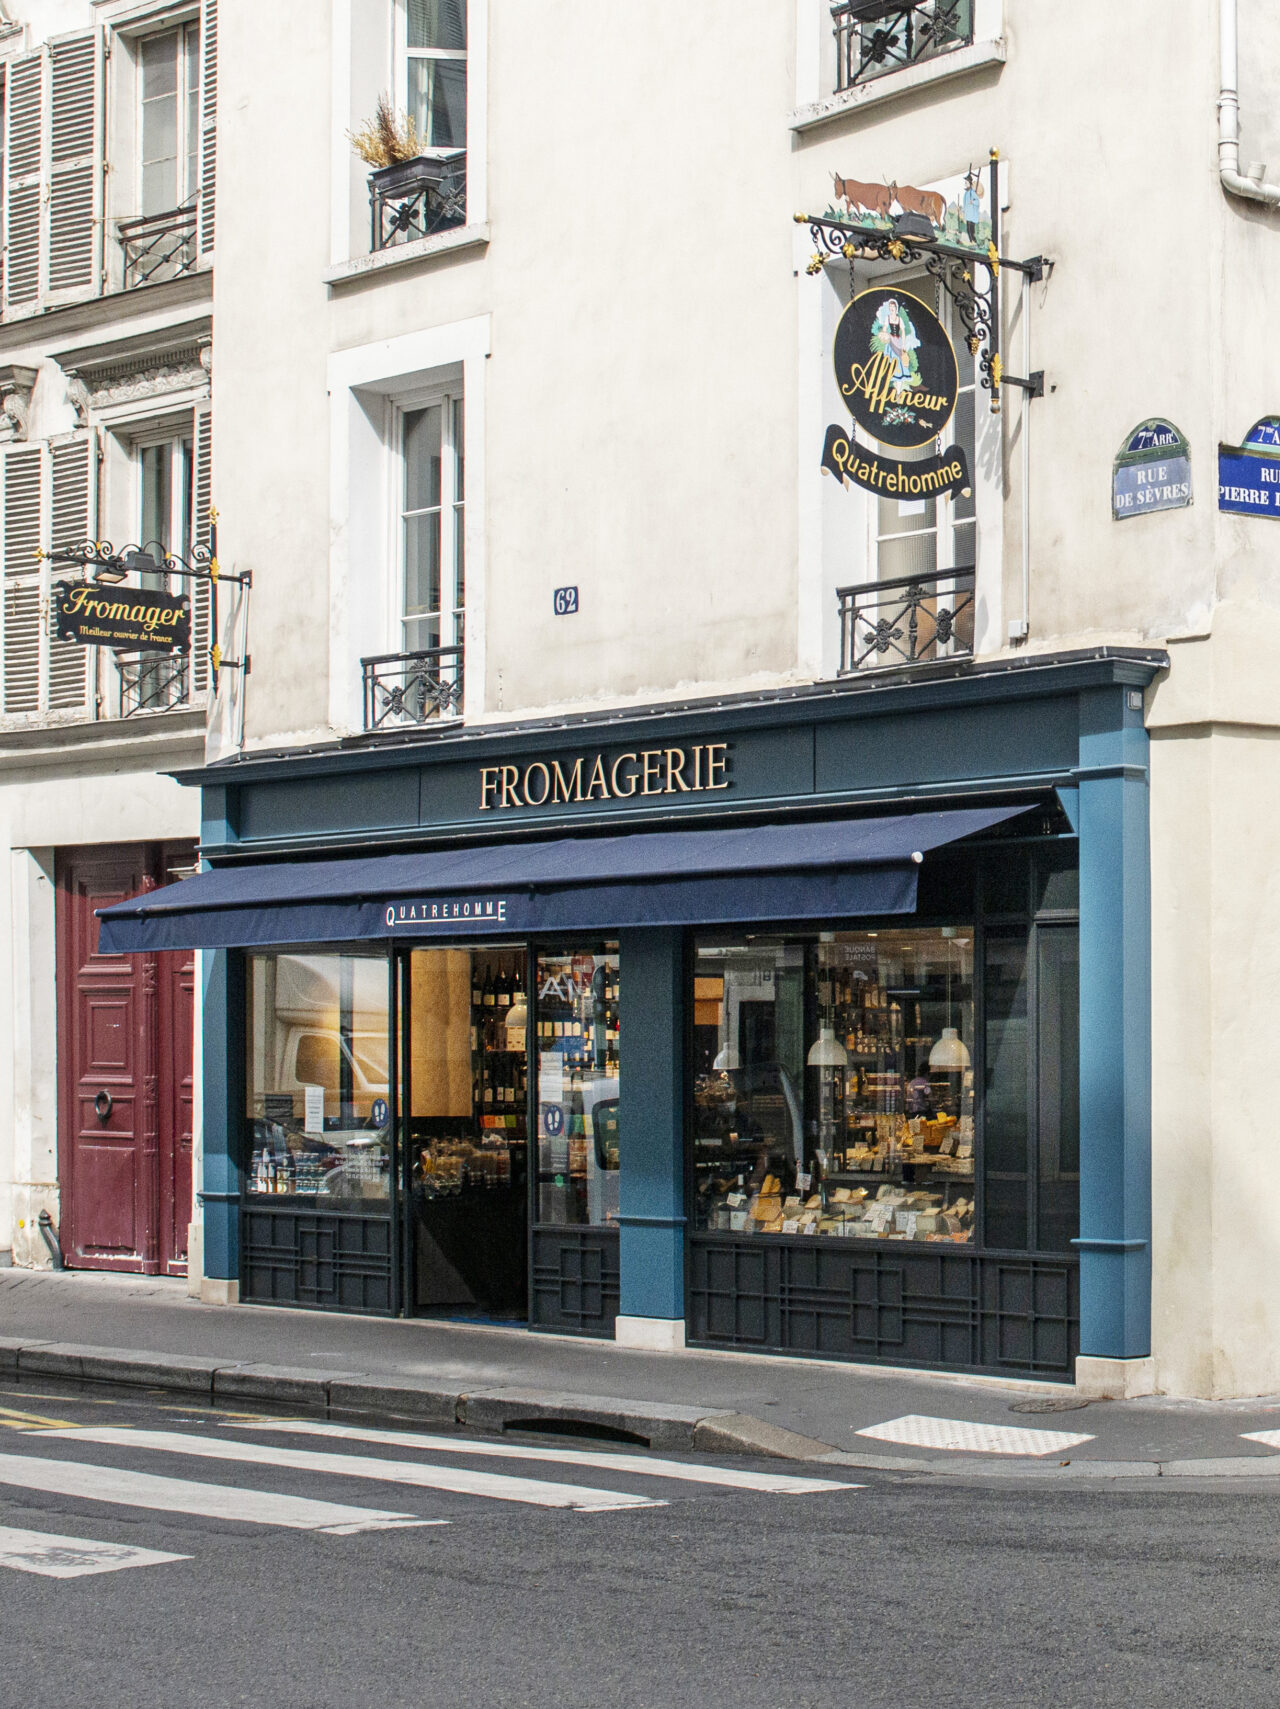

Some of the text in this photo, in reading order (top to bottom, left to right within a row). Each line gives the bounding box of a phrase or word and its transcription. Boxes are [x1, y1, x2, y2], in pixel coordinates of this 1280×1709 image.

[842, 351, 948, 413] Affineur
[832, 438, 962, 493] Quatrehomme
[1137, 467, 1167, 484] RUE
[1116, 482, 1188, 509] DE SÈVRES
[1218, 486, 1269, 505] PIERRE
[63, 588, 185, 631] Fromager
[556, 589, 575, 613] 62
[80, 625, 172, 643] Meilleur ouvrier de France
[478, 743, 728, 809] FROMAGERIE
[386, 901, 506, 926] QUATREHOMME
